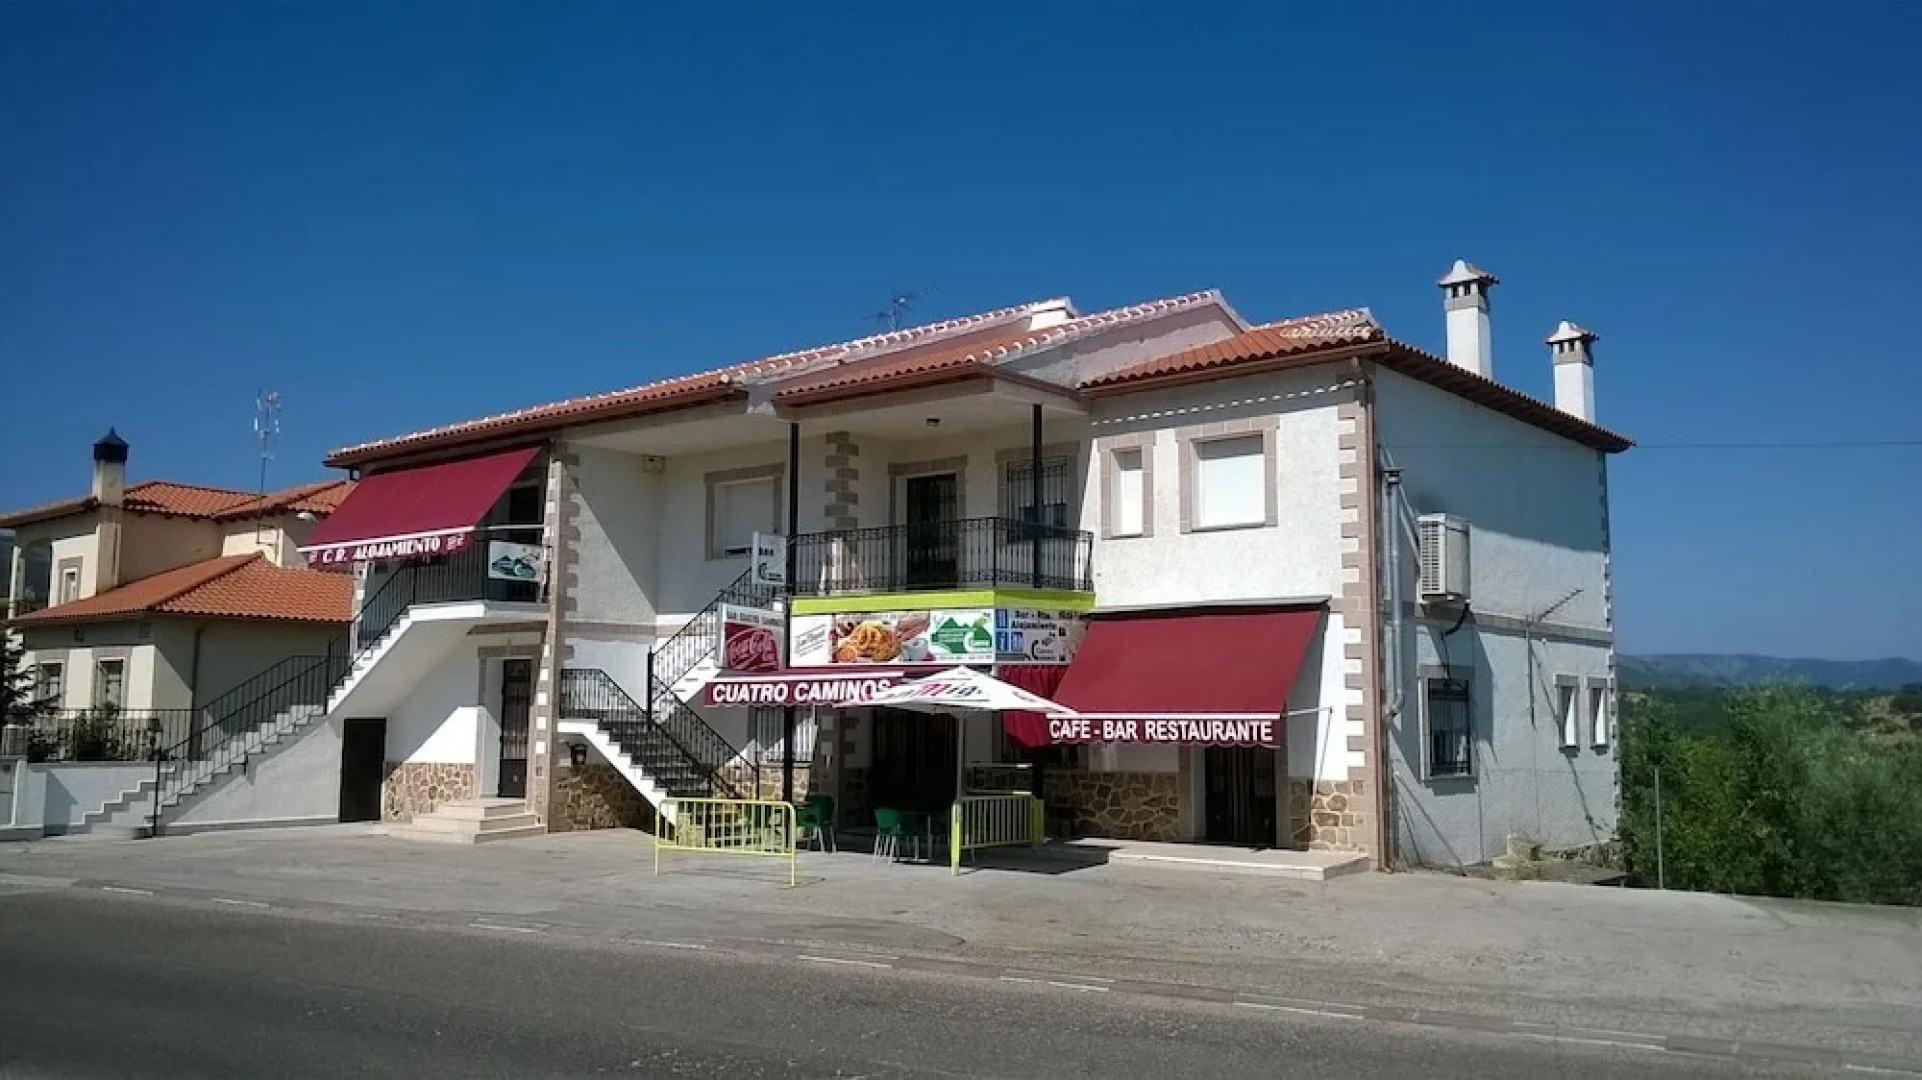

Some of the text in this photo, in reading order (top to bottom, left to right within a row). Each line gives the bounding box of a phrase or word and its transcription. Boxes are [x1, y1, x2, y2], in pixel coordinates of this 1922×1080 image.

[352, 536, 441, 560] ALOJAMIENTO
[712, 682, 789, 703] CUATRO
[794, 679, 891, 702] CAMINOS
[1144, 720, 1274, 742] RESTAURANTE
